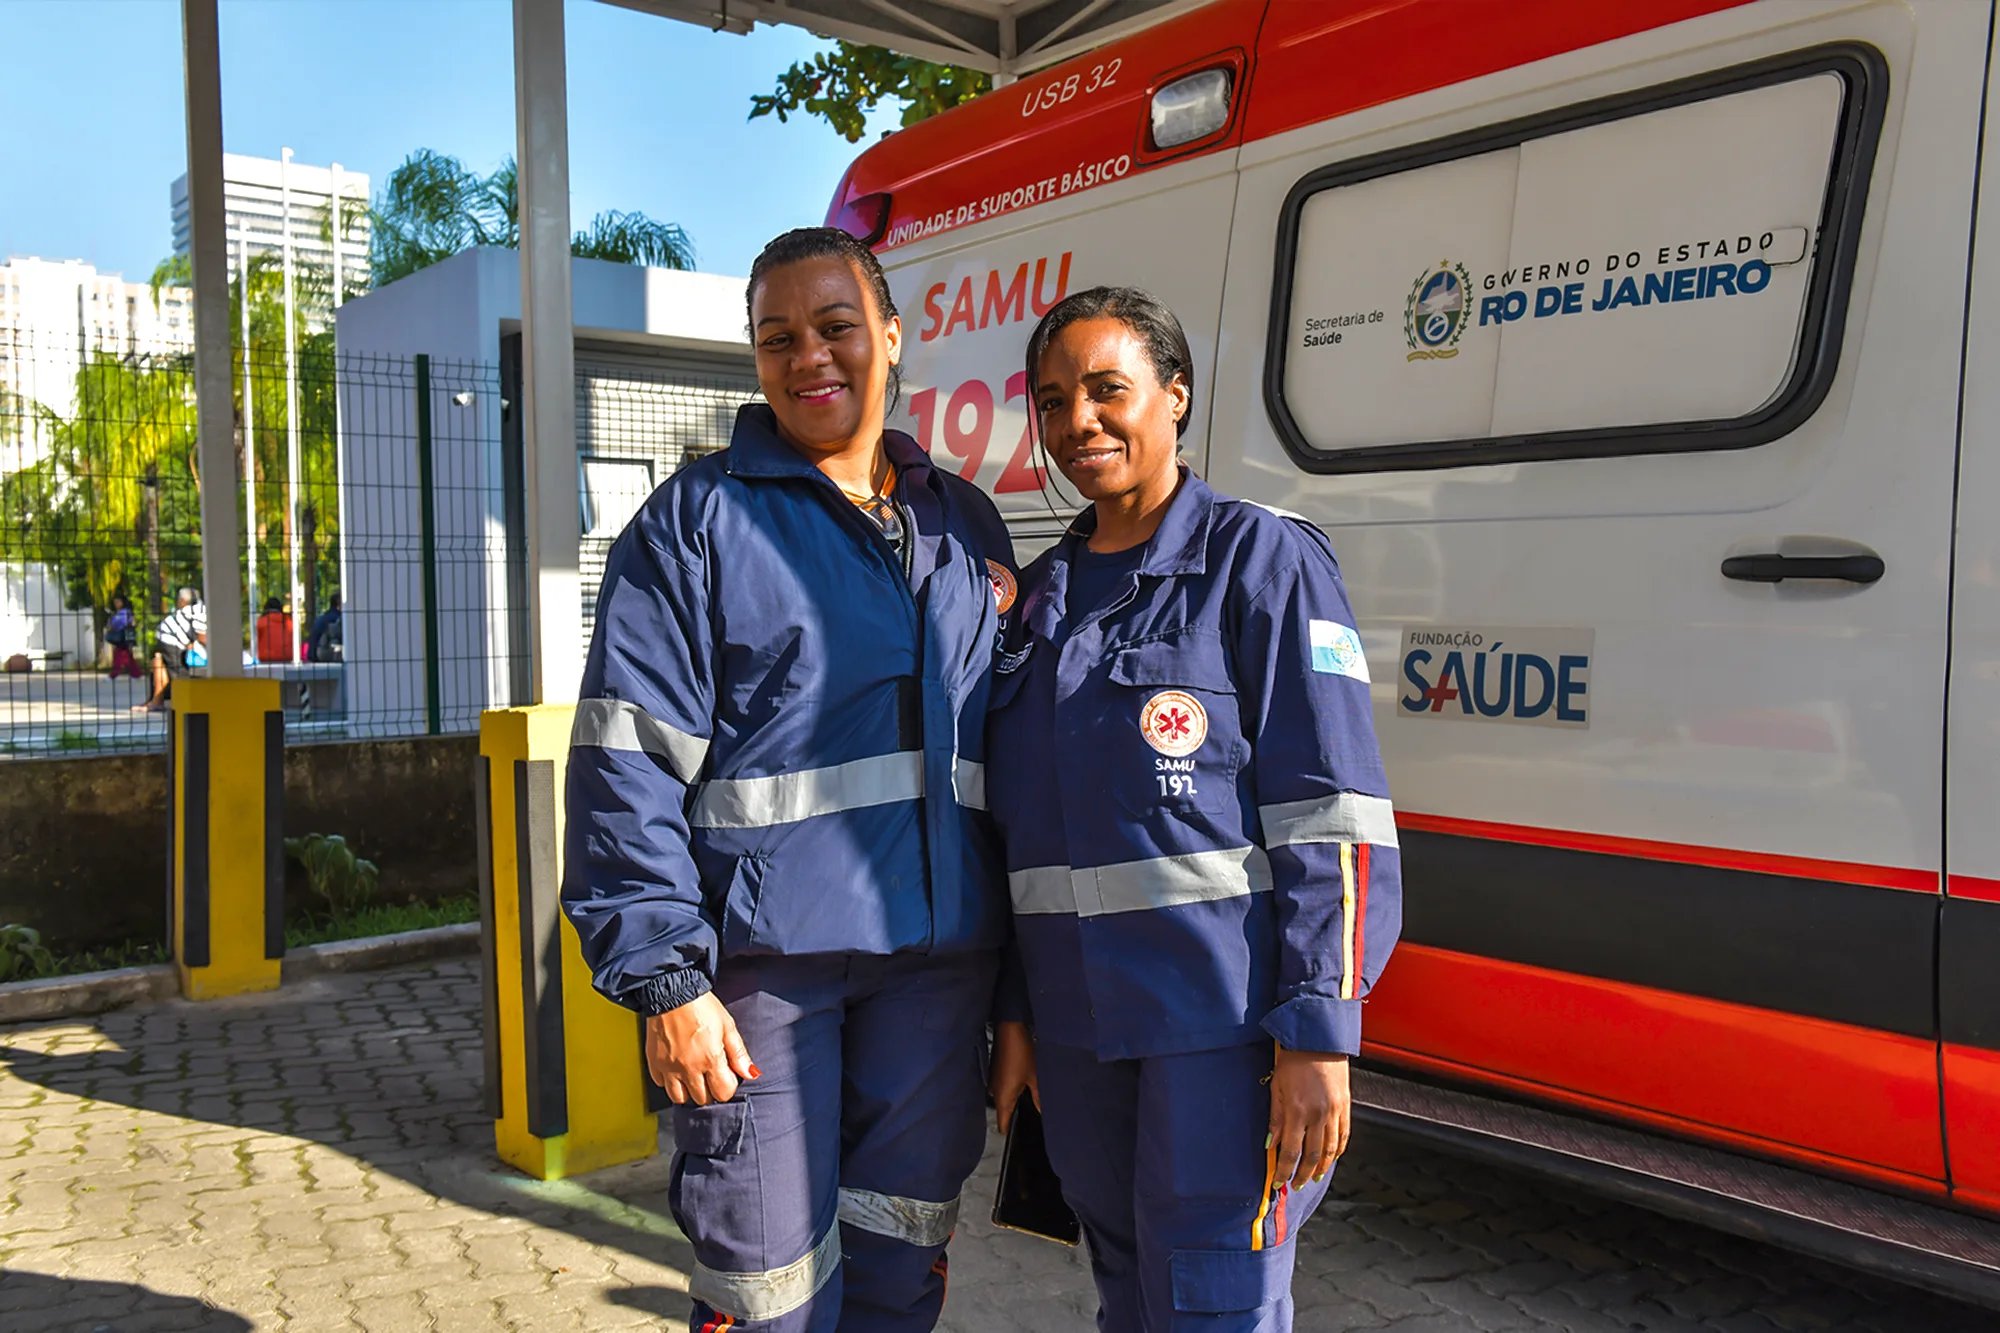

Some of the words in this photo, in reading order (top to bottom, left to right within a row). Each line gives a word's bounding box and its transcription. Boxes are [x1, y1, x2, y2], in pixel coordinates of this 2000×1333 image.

[1022, 74, 1080, 117] USB
[1085, 58, 1122, 93] 32
[887, 209, 953, 247] UNIDADE
[956, 201, 977, 225] DE
[979, 177, 1057, 219] SUPORTE
[1060, 154, 1130, 193] BÁSICO
[1606, 252, 1640, 271] DO
[1658, 232, 1773, 264] ESTADO
[920, 251, 1072, 342] SAMU
[1479, 290, 1528, 327] RO
[1534, 282, 1585, 318] DE
[1592, 259, 1772, 311] JANEIRO
[1303, 332, 1342, 347] Saúde
[1305, 312, 1365, 331] Secretaria
[1368, 309, 1384, 323] de
[908, 370, 1047, 494] 192
[1410, 632, 1483, 647] FUNDAÇÃO
[1401, 642, 1589, 722] SAÚDE
[1155, 758, 1196, 771] SAMU
[1156, 775, 1198, 797] 192
